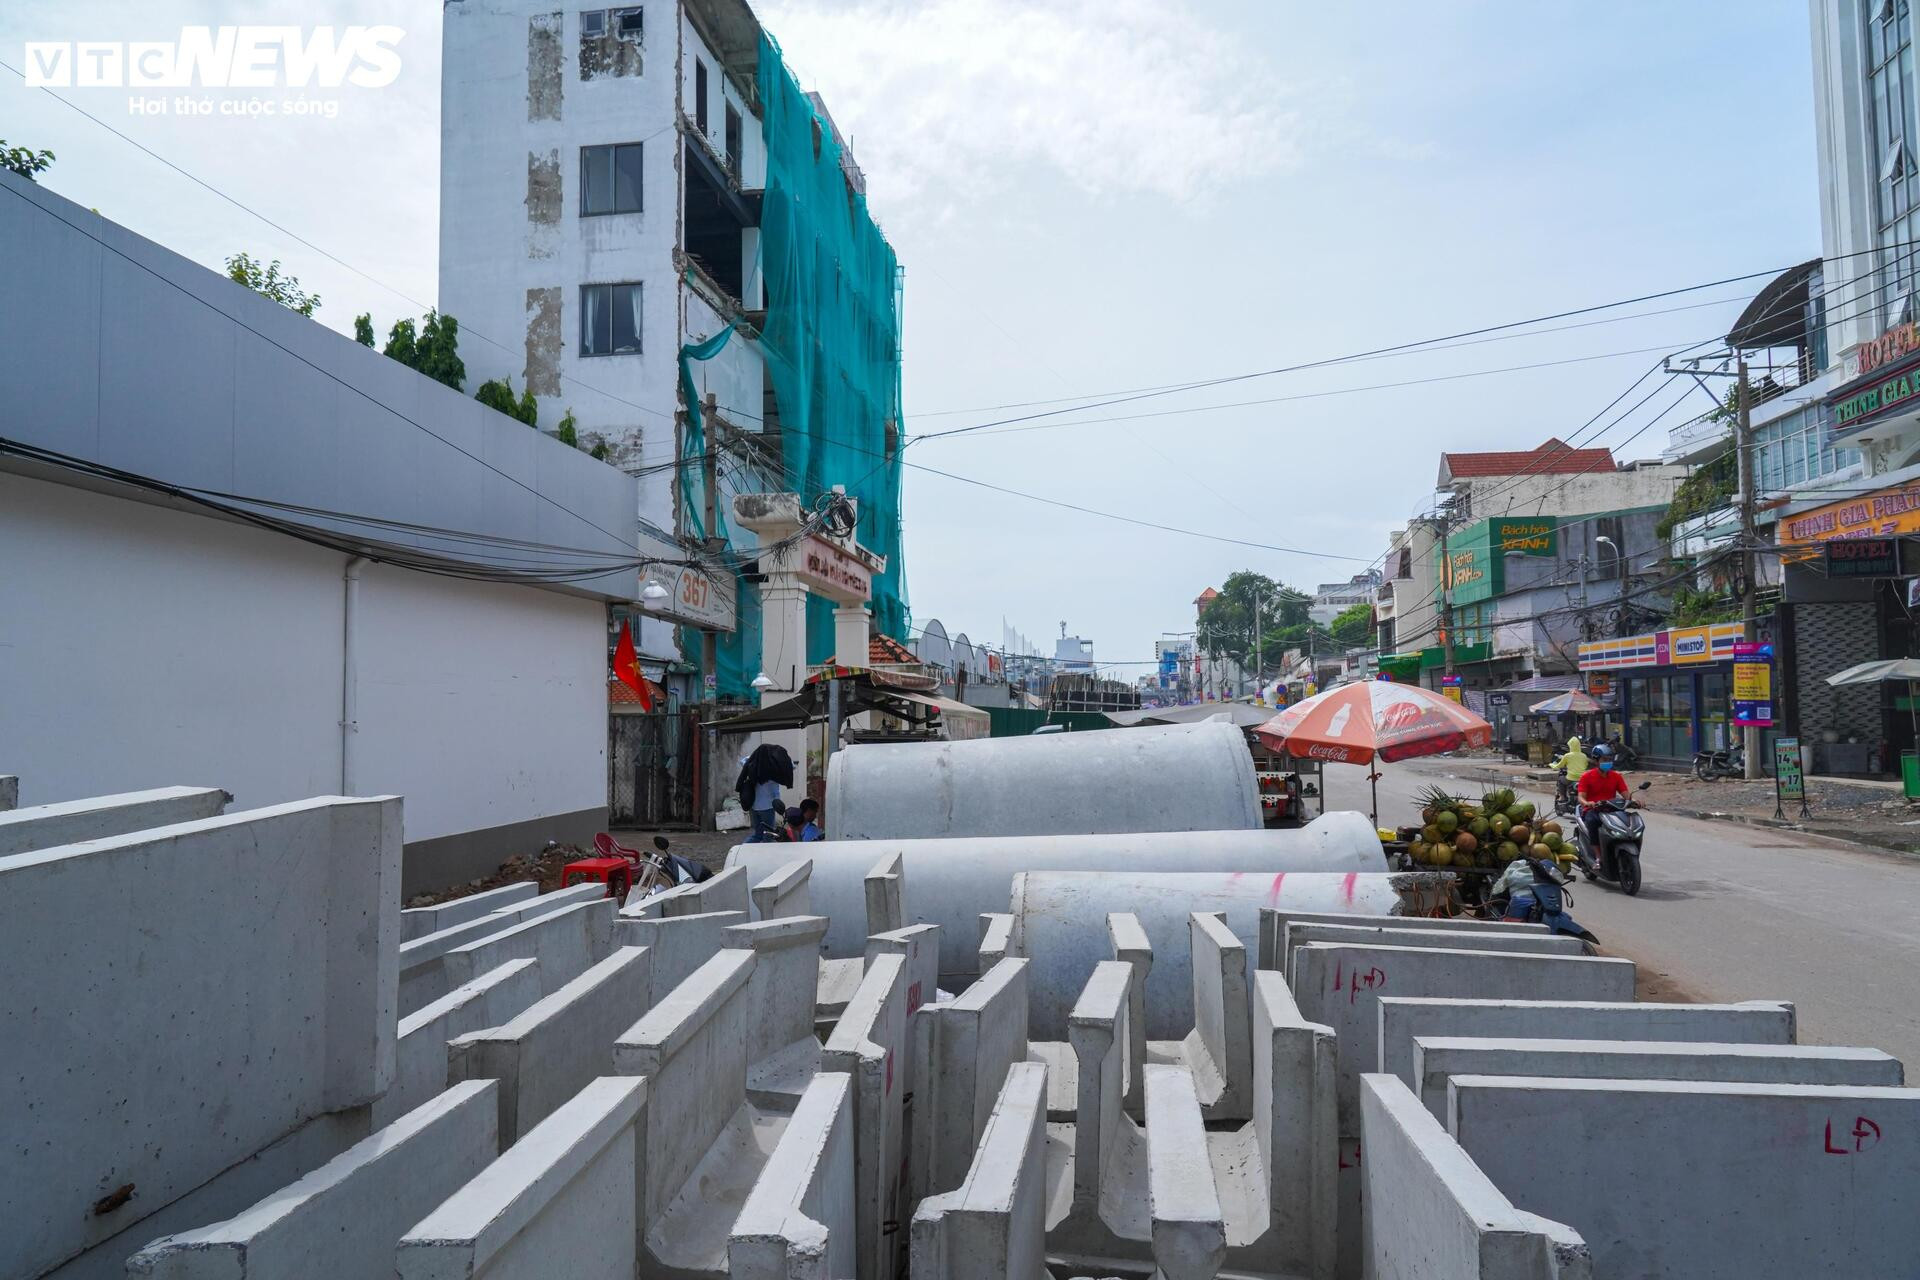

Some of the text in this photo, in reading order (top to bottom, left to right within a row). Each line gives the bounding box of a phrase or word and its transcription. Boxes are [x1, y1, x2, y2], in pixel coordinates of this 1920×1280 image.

[1857, 322, 1920, 373] HOTEL
[1881, 376, 1911, 405] GIA
[1839, 503, 1870, 528] GIA
[1502, 538, 1549, 550] XANH
[1832, 541, 1889, 559] HOTEL
[683, 572, 708, 609] 367
[1777, 754, 1791, 764] 14
[1788, 774, 1800, 785] 17
[1825, 1116, 1881, 1154] LP
